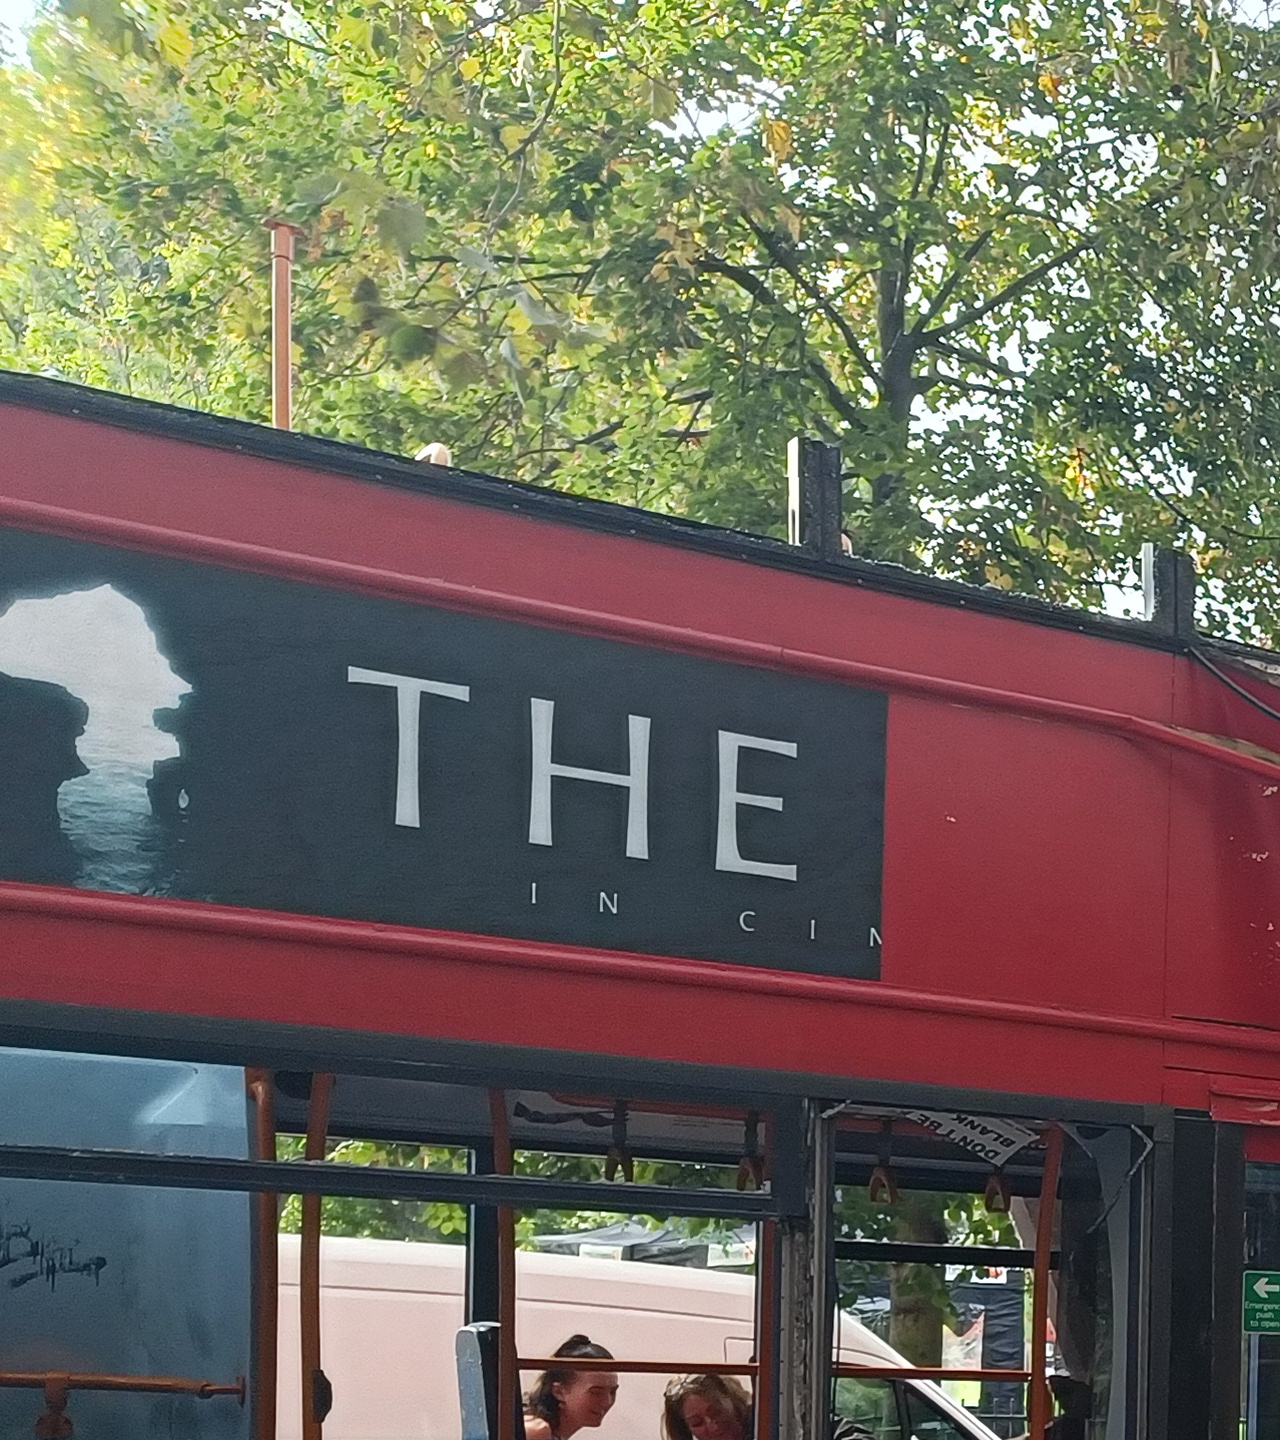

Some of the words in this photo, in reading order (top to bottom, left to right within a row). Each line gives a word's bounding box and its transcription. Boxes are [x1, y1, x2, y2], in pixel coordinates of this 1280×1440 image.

[347, 665, 798, 882] THE
[530, 882, 619, 915] IN
[915, 1113, 943, 1131] BE
[950, 1113, 1017, 1149] BLANK
[943, 1128, 1002, 1162] DON'T
[1250, 1320, 1259, 1328] to
[1260, 1321, 1280, 1329] open
[1255, 1312, 1275, 1320] push
